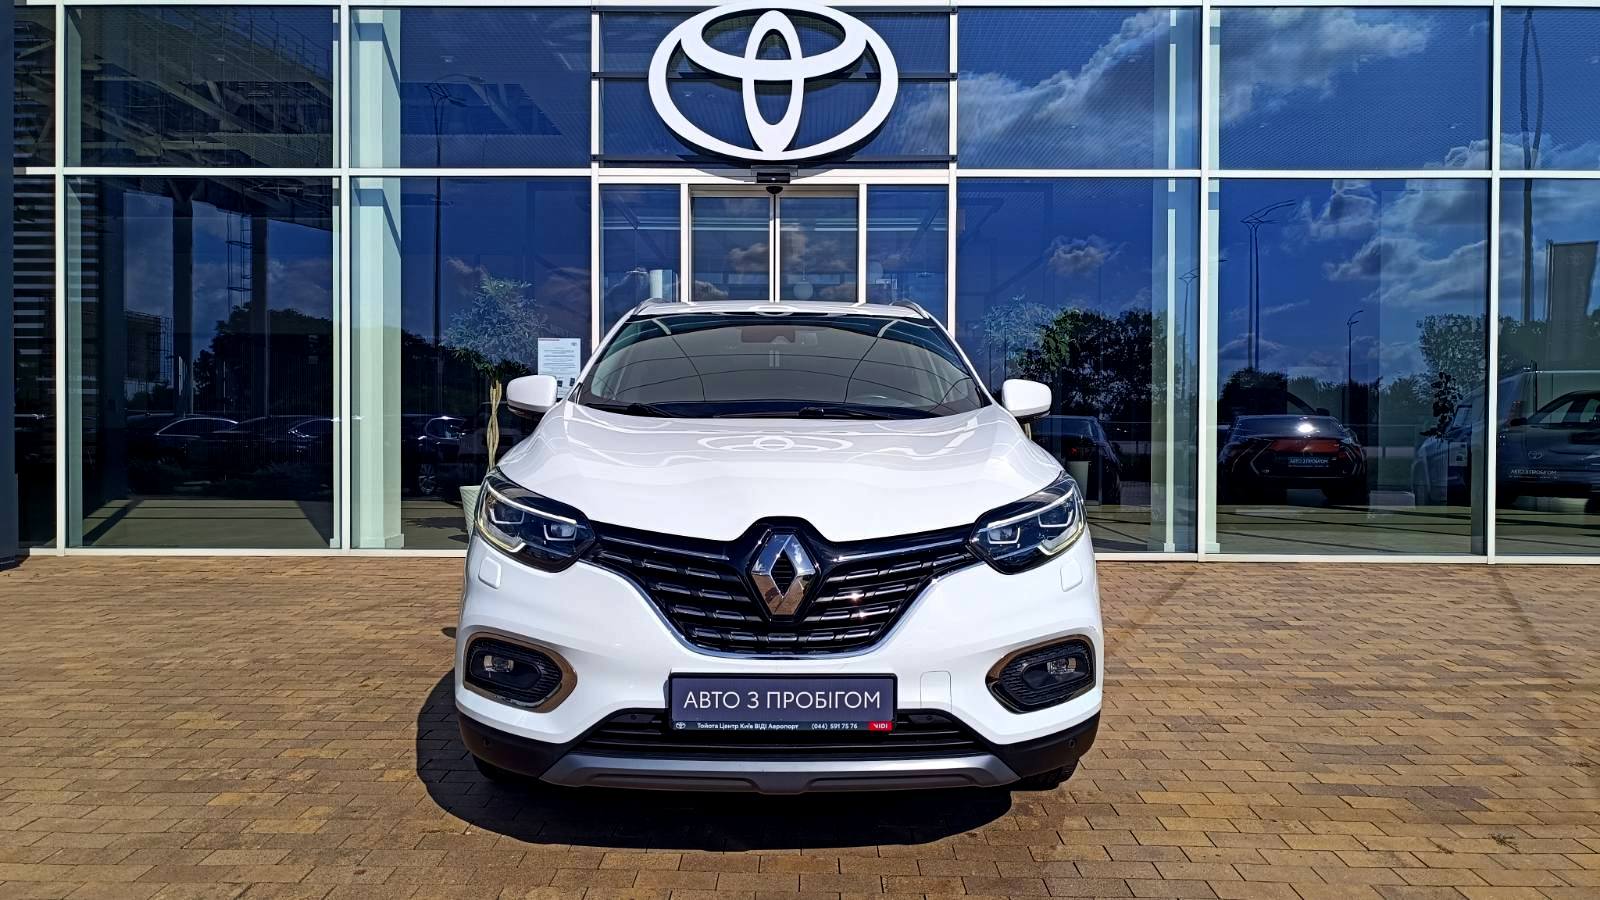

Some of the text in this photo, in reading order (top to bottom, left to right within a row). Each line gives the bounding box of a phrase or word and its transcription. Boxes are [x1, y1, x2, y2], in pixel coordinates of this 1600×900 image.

[683, 691, 881, 709] АВТО З ПРОБІГОМ
[719, 722, 739, 731] Центр
[768, 723, 799, 731] Аеропорт
